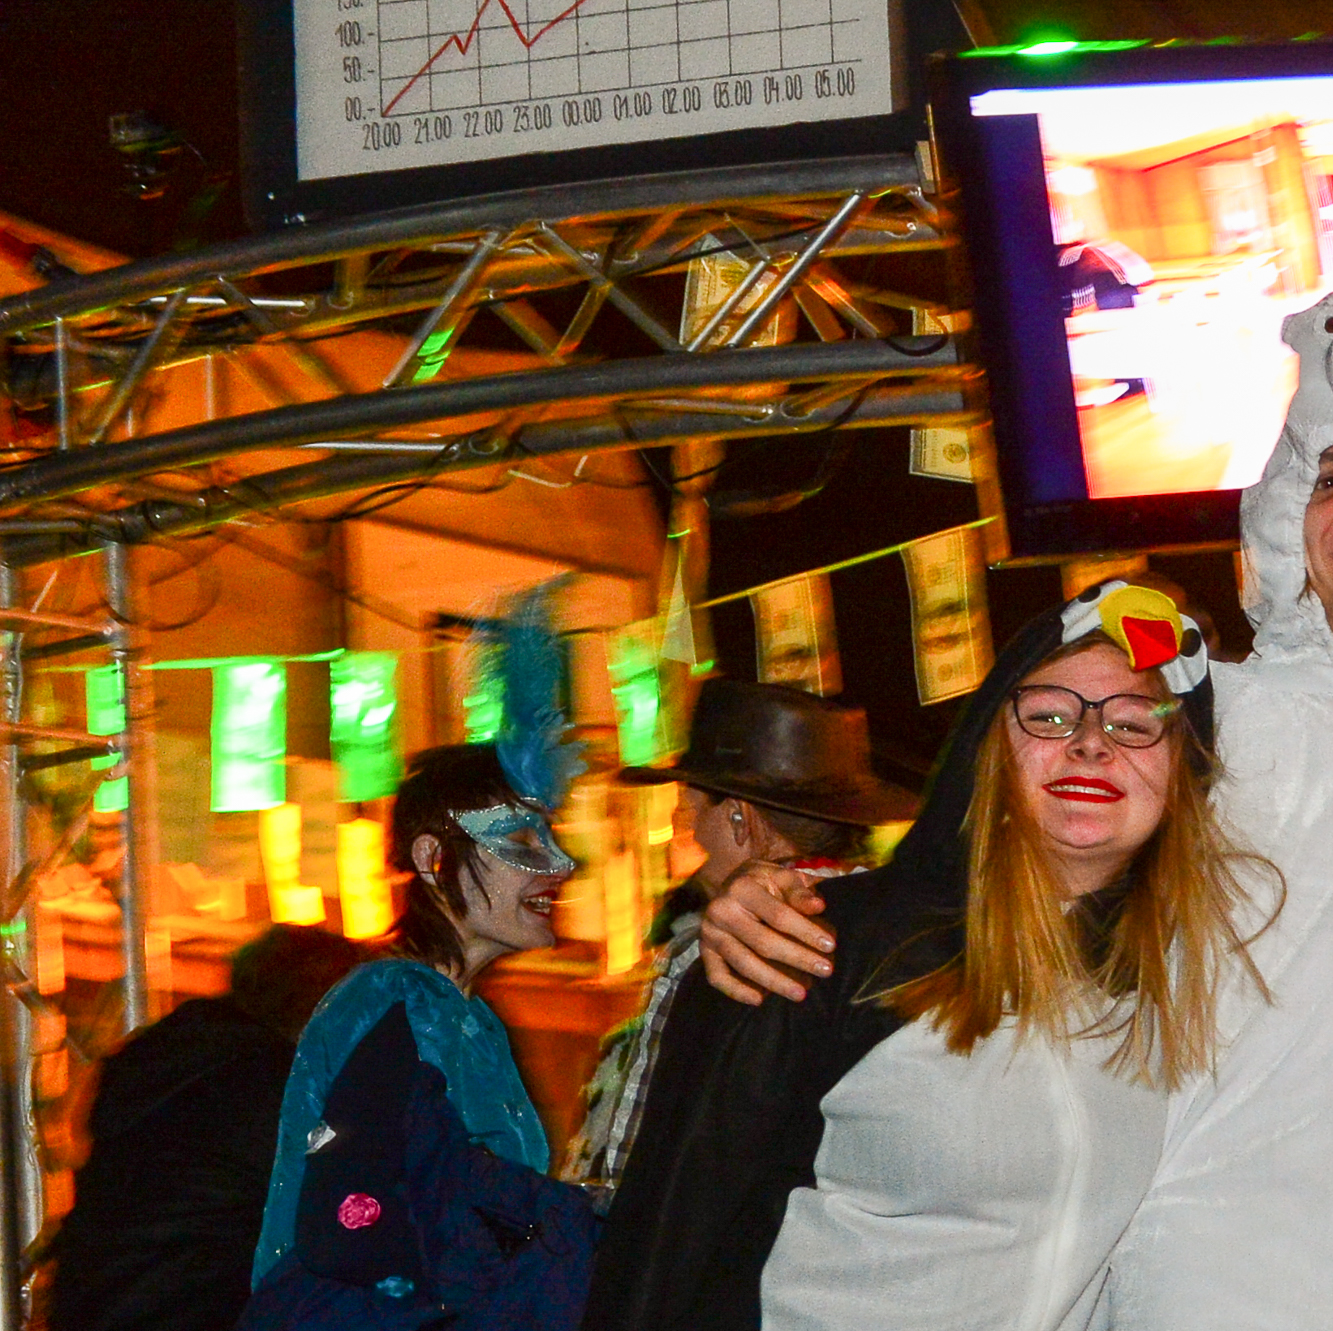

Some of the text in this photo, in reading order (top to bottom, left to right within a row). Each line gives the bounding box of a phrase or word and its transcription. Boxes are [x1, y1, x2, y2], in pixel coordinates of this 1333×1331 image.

[362, 68, 856, 151] 20.00 21.00 22.00 23.00 00.00 01.00 02.00 03.00 04.00 05.00
